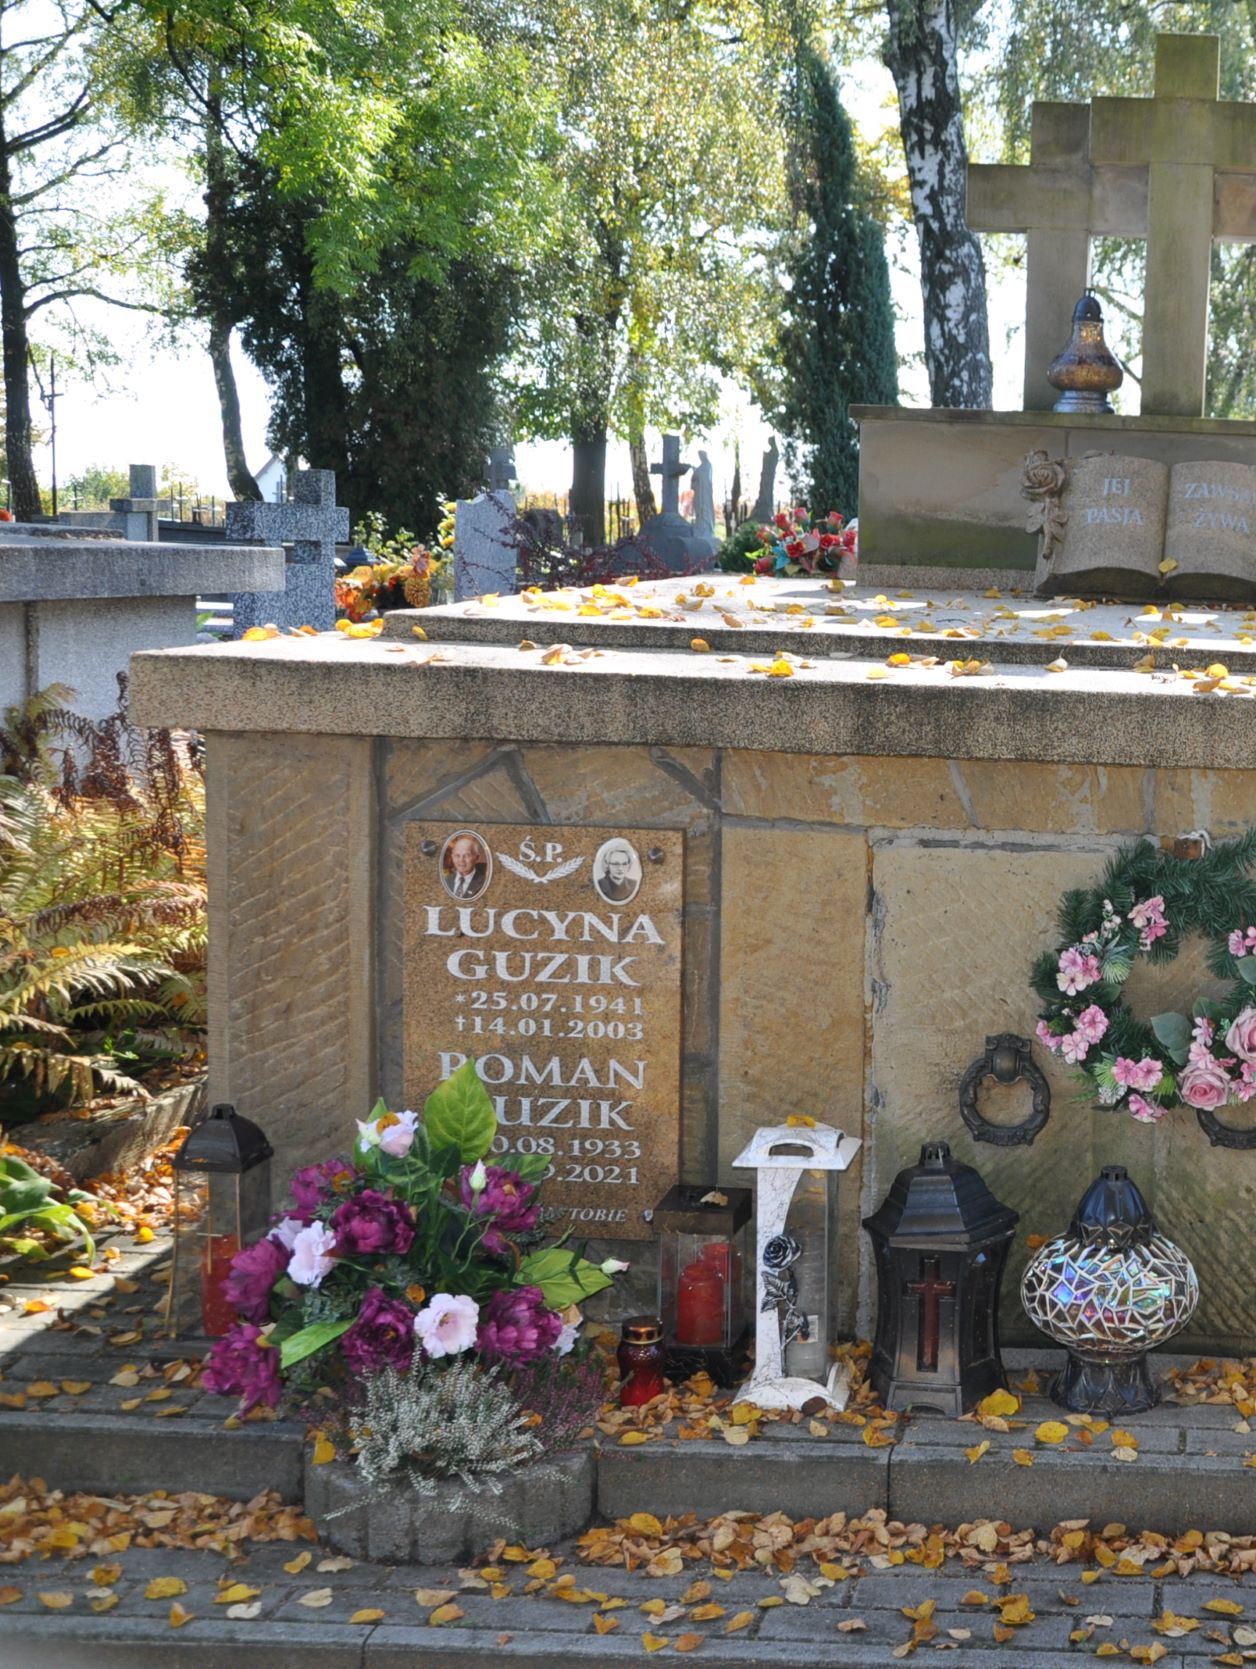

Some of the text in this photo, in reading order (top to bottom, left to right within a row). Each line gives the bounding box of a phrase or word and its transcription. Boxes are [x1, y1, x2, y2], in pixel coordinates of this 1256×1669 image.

[1103, 478, 1132, 496] JEJ
[519, 836, 563, 862] Ś.P.
[423, 905, 666, 945] LUCYNA
[446, 950, 641, 986] GUZIK
[438, 1051, 648, 1089] ROMAN
[492, 1095, 635, 1131] UZIK
[490, 1135, 641, 1159] 0.08.1933
[569, 1207, 628, 1223] TOBIE
